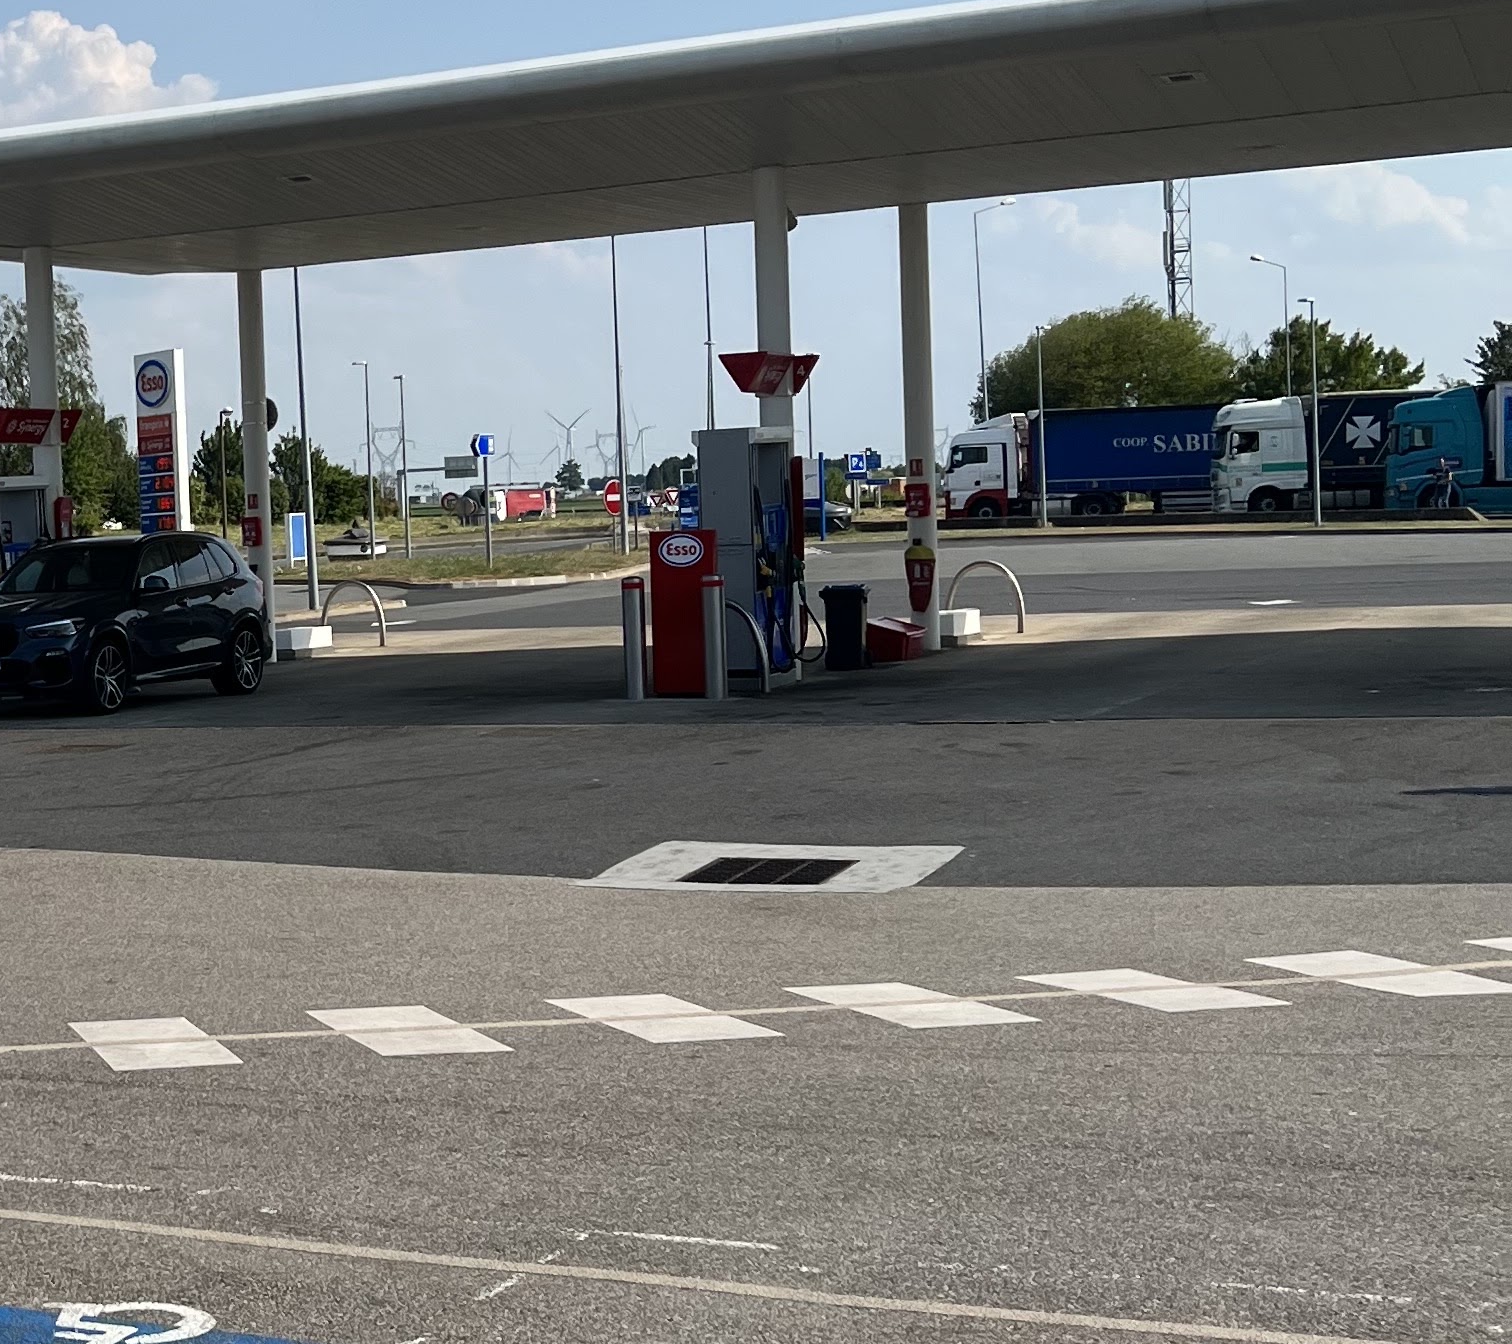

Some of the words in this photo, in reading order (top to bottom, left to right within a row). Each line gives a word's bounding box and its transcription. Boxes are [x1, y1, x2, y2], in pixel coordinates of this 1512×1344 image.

[796, 364, 806, 376] 4
[141, 373, 164, 392] Esso
[62, 418, 70, 429] 2
[666, 542, 697, 556] Esso
